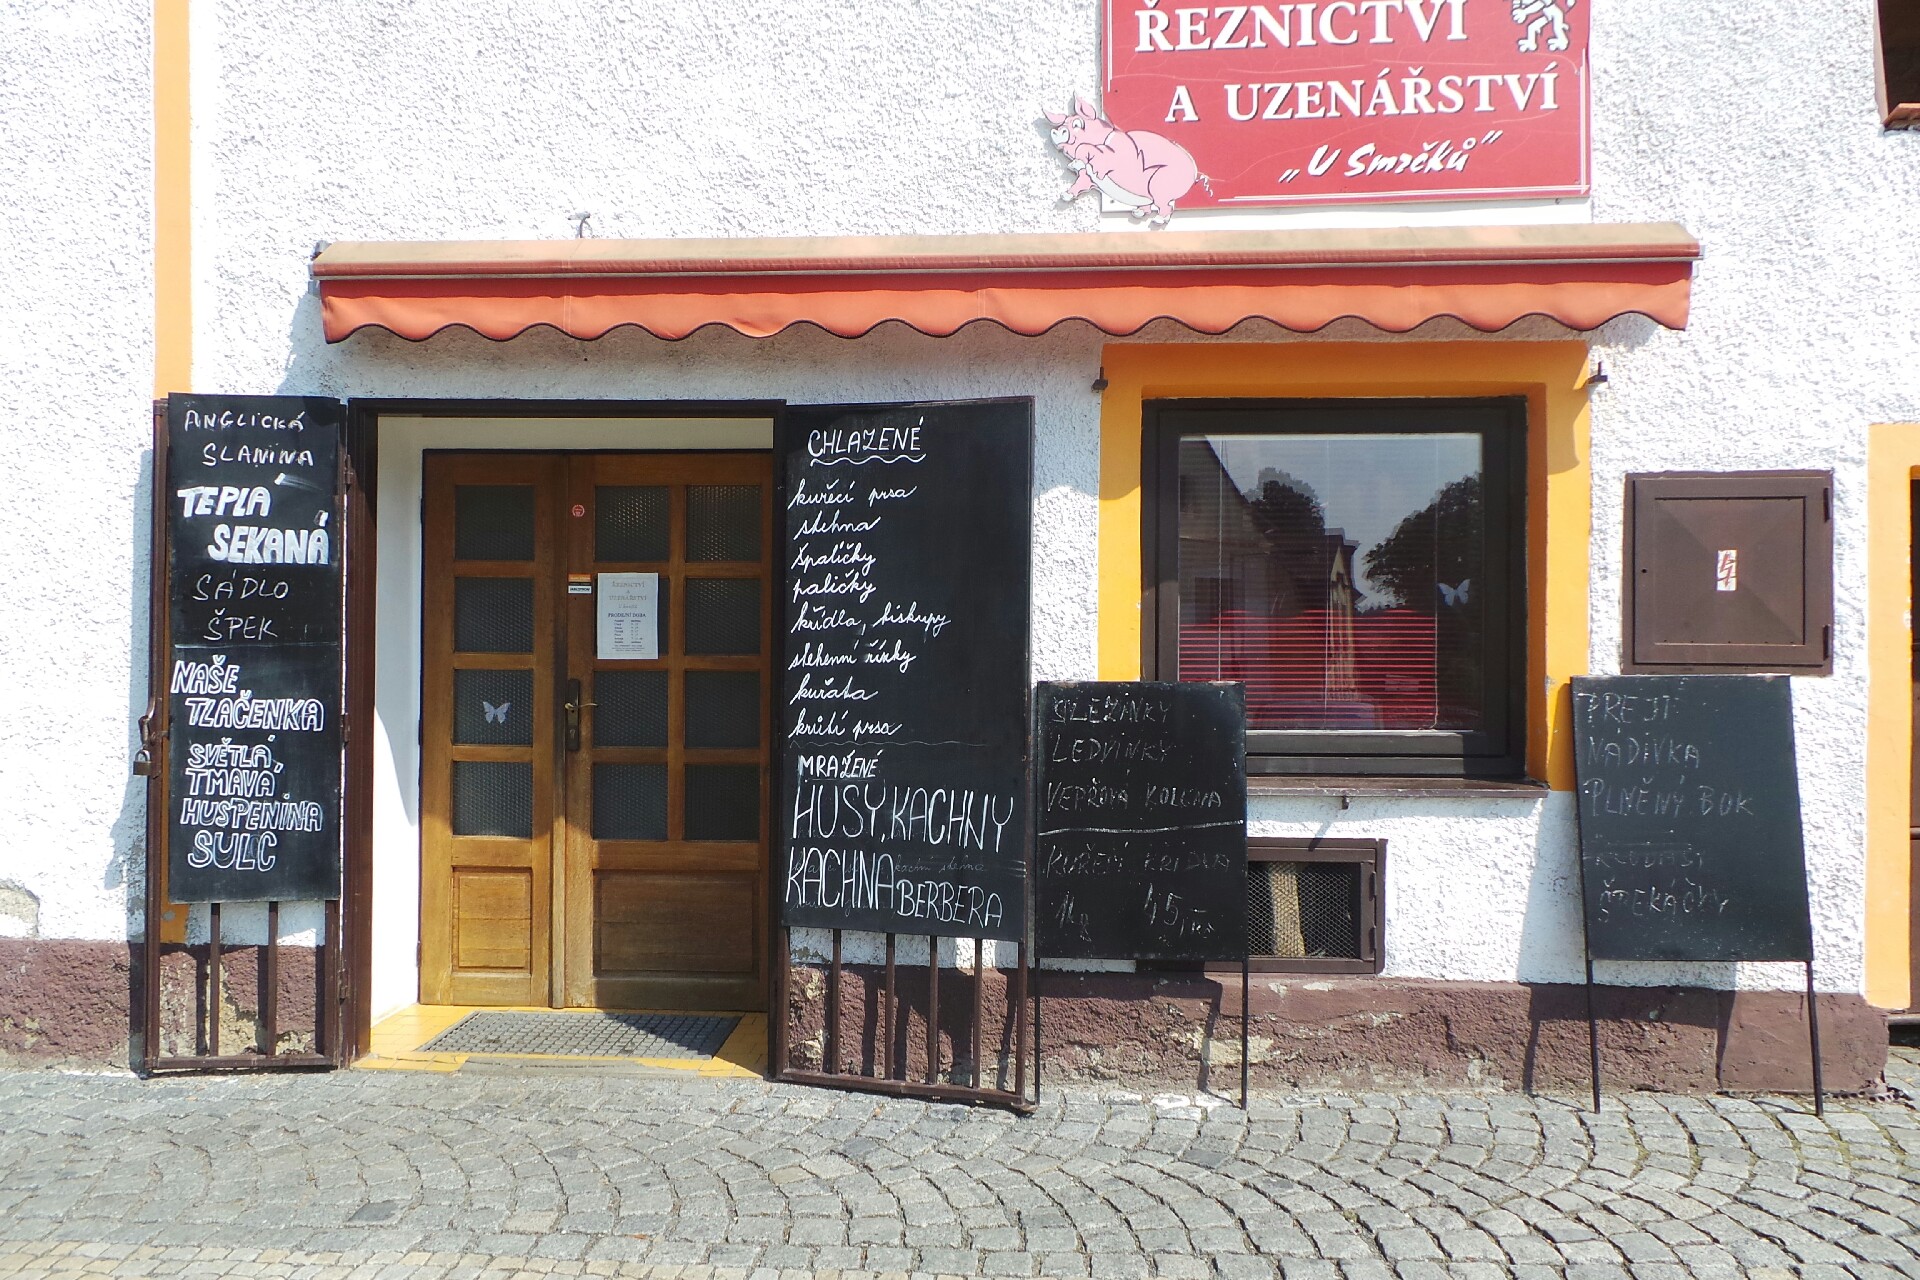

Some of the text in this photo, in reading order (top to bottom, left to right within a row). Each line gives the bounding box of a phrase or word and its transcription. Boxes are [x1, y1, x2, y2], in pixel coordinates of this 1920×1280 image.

[1165, 62, 1559, 124] A UZENÁŘSTVÍ
[184, 410, 306, 432] ANGLICKÁ
[807, 416, 925, 457] CHLAZENÉ
[202, 442, 314, 467] SLANINA
[787, 478, 918, 510] kuřecí prsa
[207, 510, 330, 565] SEKANÁ
[793, 509, 882, 540] stehna
[192, 568, 290, 601] SÁDLO
[792, 568, 877, 604] paličky
[203, 608, 279, 641] ŠPEK
[872, 601, 952, 638] biskupy
[170, 655, 240, 694] NAŠE
[789, 672, 879, 705] kuřata
[185, 689, 326, 732] TLAČENKA
[853, 719, 903, 741] prsa
[185, 762, 284, 797] TMAVÁ
[797, 749, 884, 779] MRAŽENÉ
[180, 792, 325, 832] HUSPENINA
[1697, 785, 1754, 817] BOK
[890, 786, 1014, 853] KACHNY
[188, 829, 277, 872] SULC
[785, 846, 894, 911] KACHNA
[896, 879, 1003, 929] BERBERA
